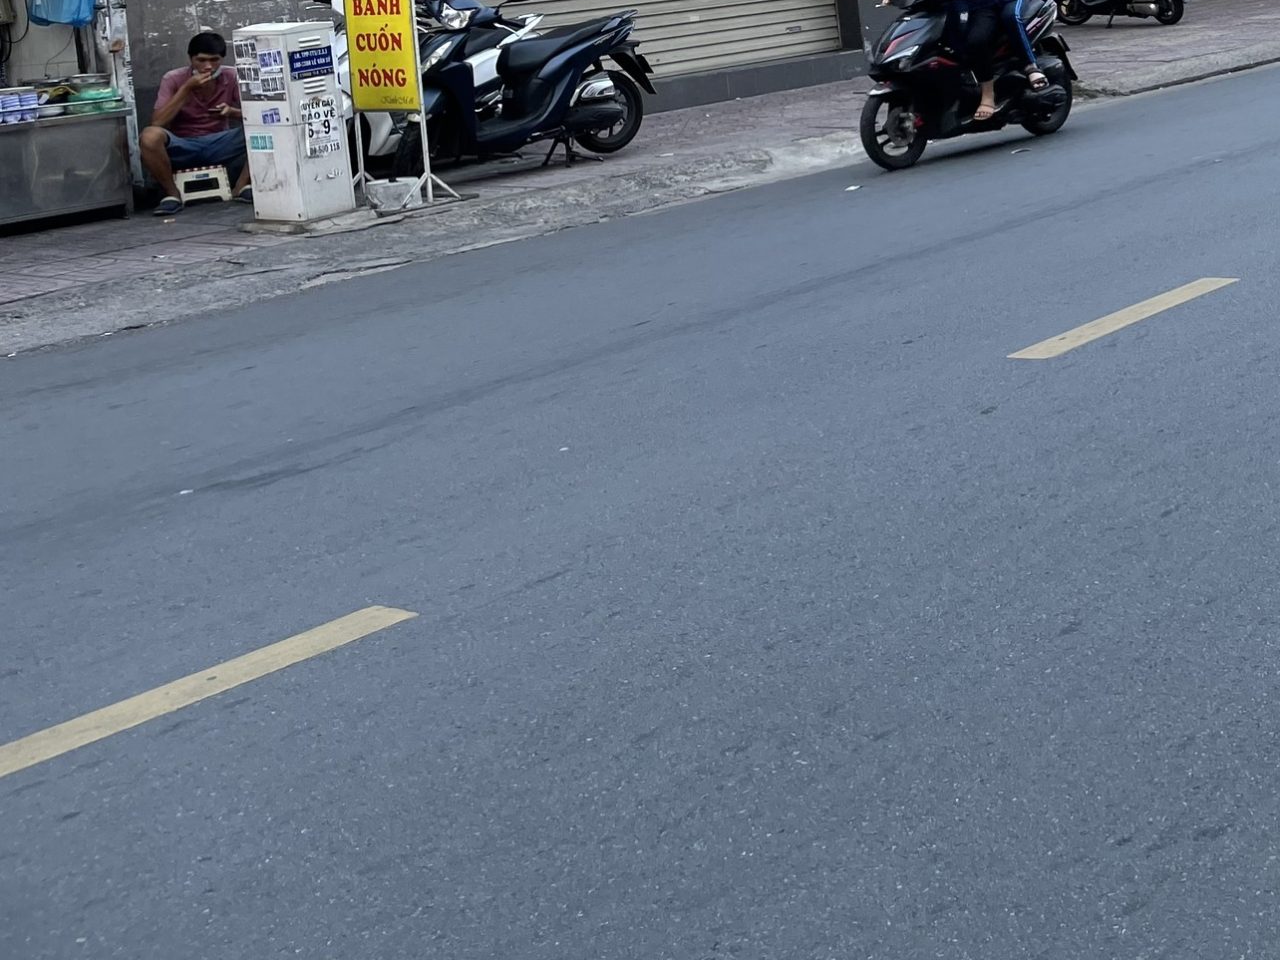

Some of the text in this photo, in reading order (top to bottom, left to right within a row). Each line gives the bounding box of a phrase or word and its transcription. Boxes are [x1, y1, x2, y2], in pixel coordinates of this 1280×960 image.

[356, 23, 402, 51] CUỐN
[358, 63, 407, 88] NÓNG
[301, 100, 320, 111] UYỂN
[323, 119, 331, 135] 9
